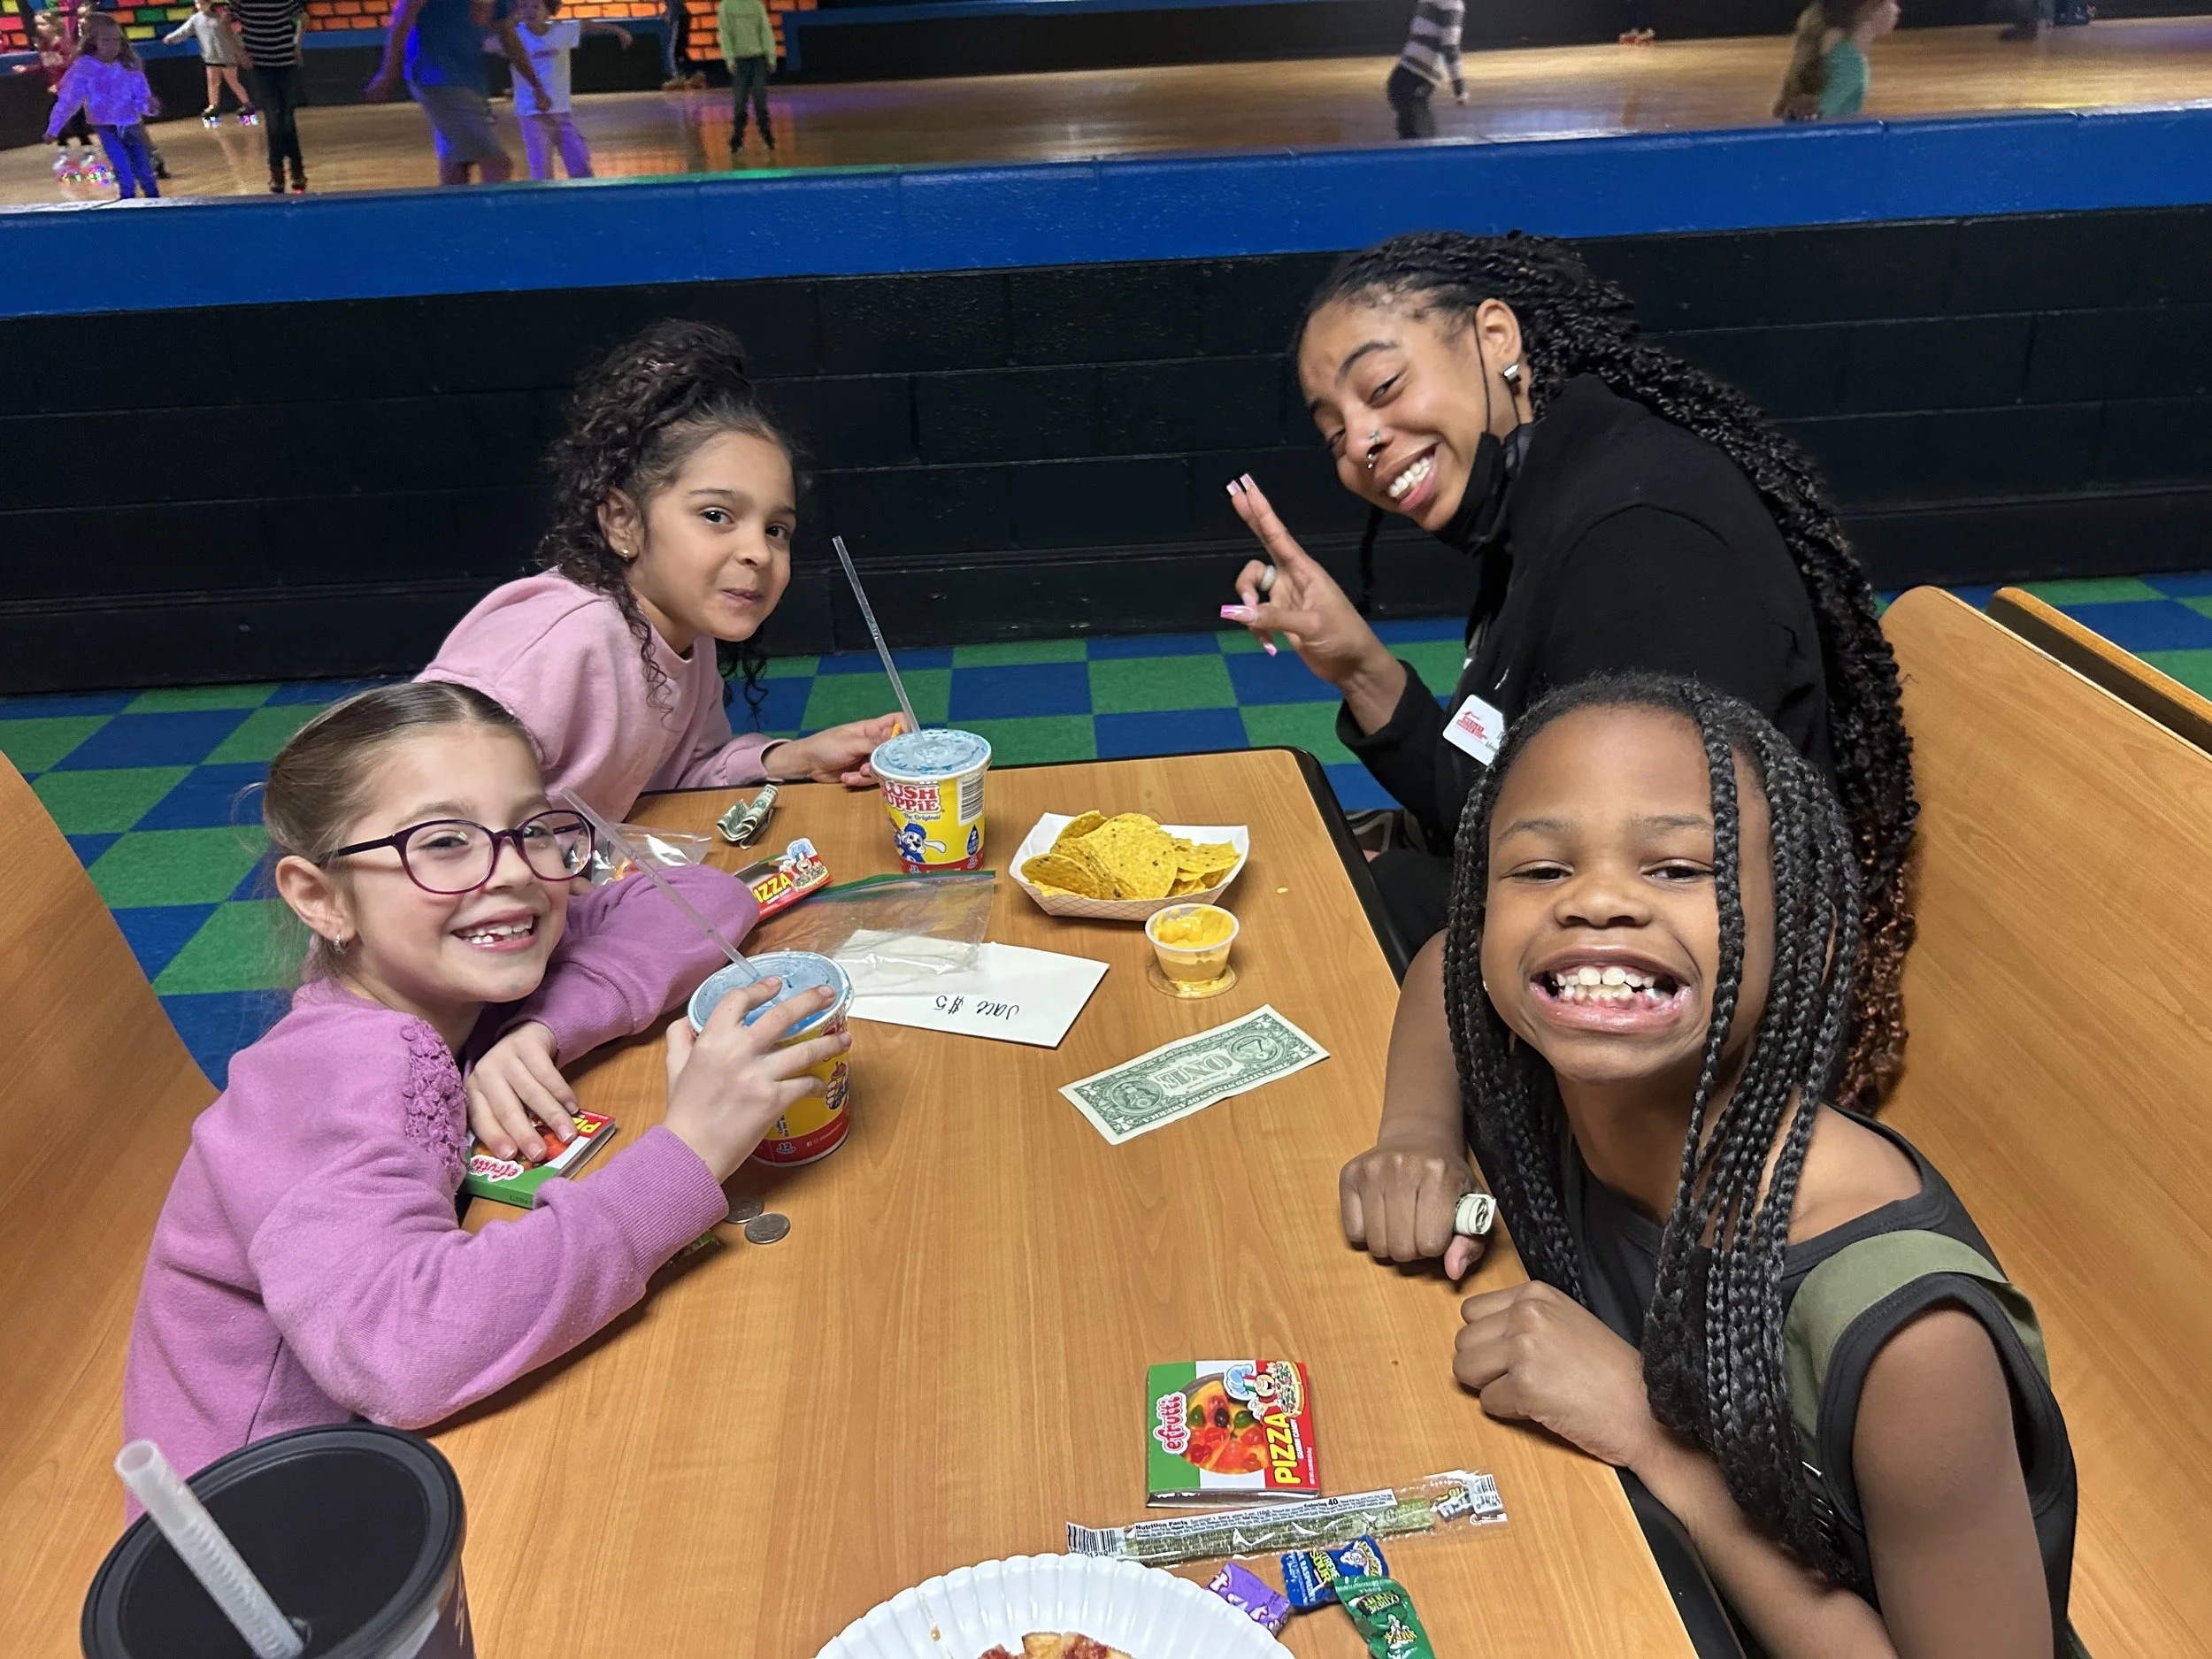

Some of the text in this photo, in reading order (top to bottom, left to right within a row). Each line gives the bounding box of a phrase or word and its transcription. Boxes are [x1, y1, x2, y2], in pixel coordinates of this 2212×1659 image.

[881, 780, 937, 800] LUSH
[914, 813, 941, 822] Original
[753, 872, 793, 903] IZZA
[933, 995, 965, 1015] $5
[1155, 1053, 1233, 1090] ONE
[1141, 1098, 1187, 1124] AMERICA
[1156, 1391, 1187, 1451] efrutti
[1263, 1412, 1302, 1485] PIZZA
[1135, 1521, 1168, 1531] Nutrition
[1168, 1518, 1188, 1527] Facts
[1328, 1497, 1339, 1506] 40
[1310, 1548, 1333, 1583] SOUR
